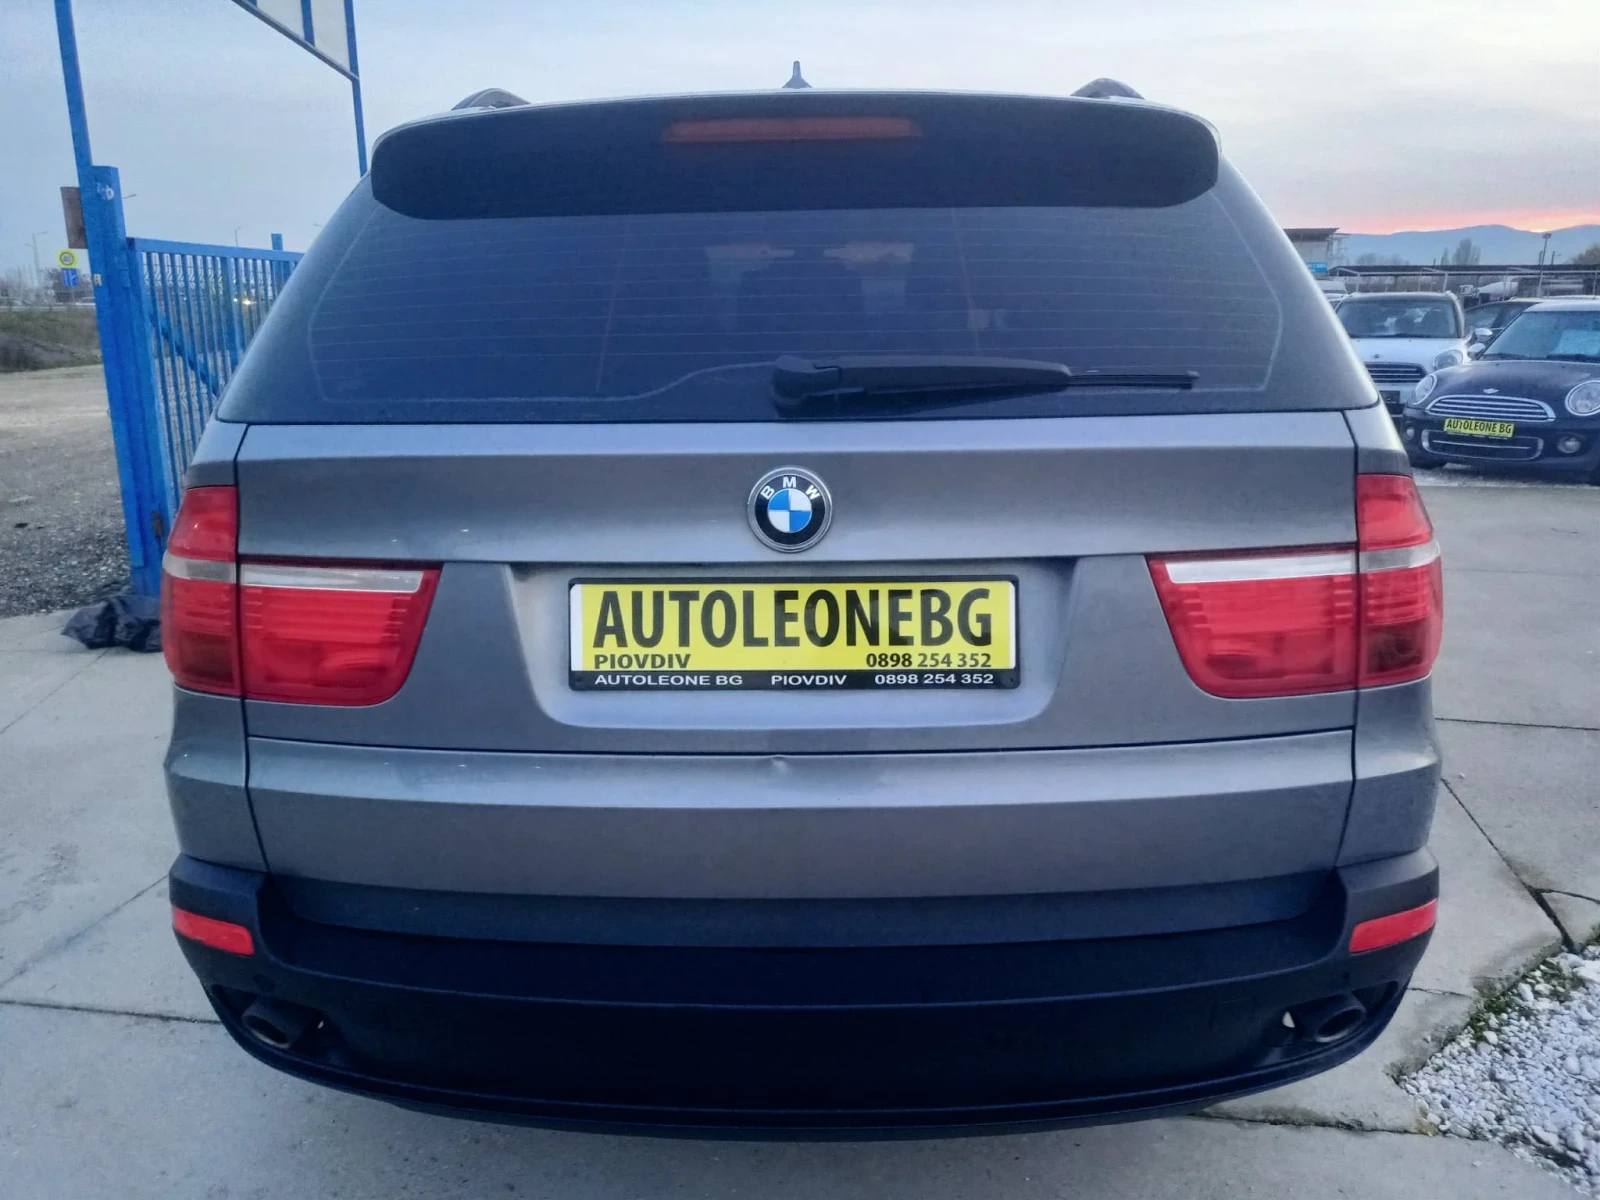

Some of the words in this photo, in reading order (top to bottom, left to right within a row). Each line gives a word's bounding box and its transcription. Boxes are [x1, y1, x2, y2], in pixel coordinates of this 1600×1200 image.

[1498, 423, 1512, 434] BG
[760, 476, 820, 500] BMW
[594, 653, 691, 669] PIOVDIV
[866, 653, 913, 668] 0898
[917, 653, 952, 668] 254
[957, 653, 992, 668] 352
[594, 674, 711, 686] AUTOLEONE
[715, 674, 743, 686] BG
[770, 674, 847, 686] PIOVDIV
[874, 674, 919, 685] 0898
[923, 674, 956, 685] 254
[960, 674, 994, 685] 352
